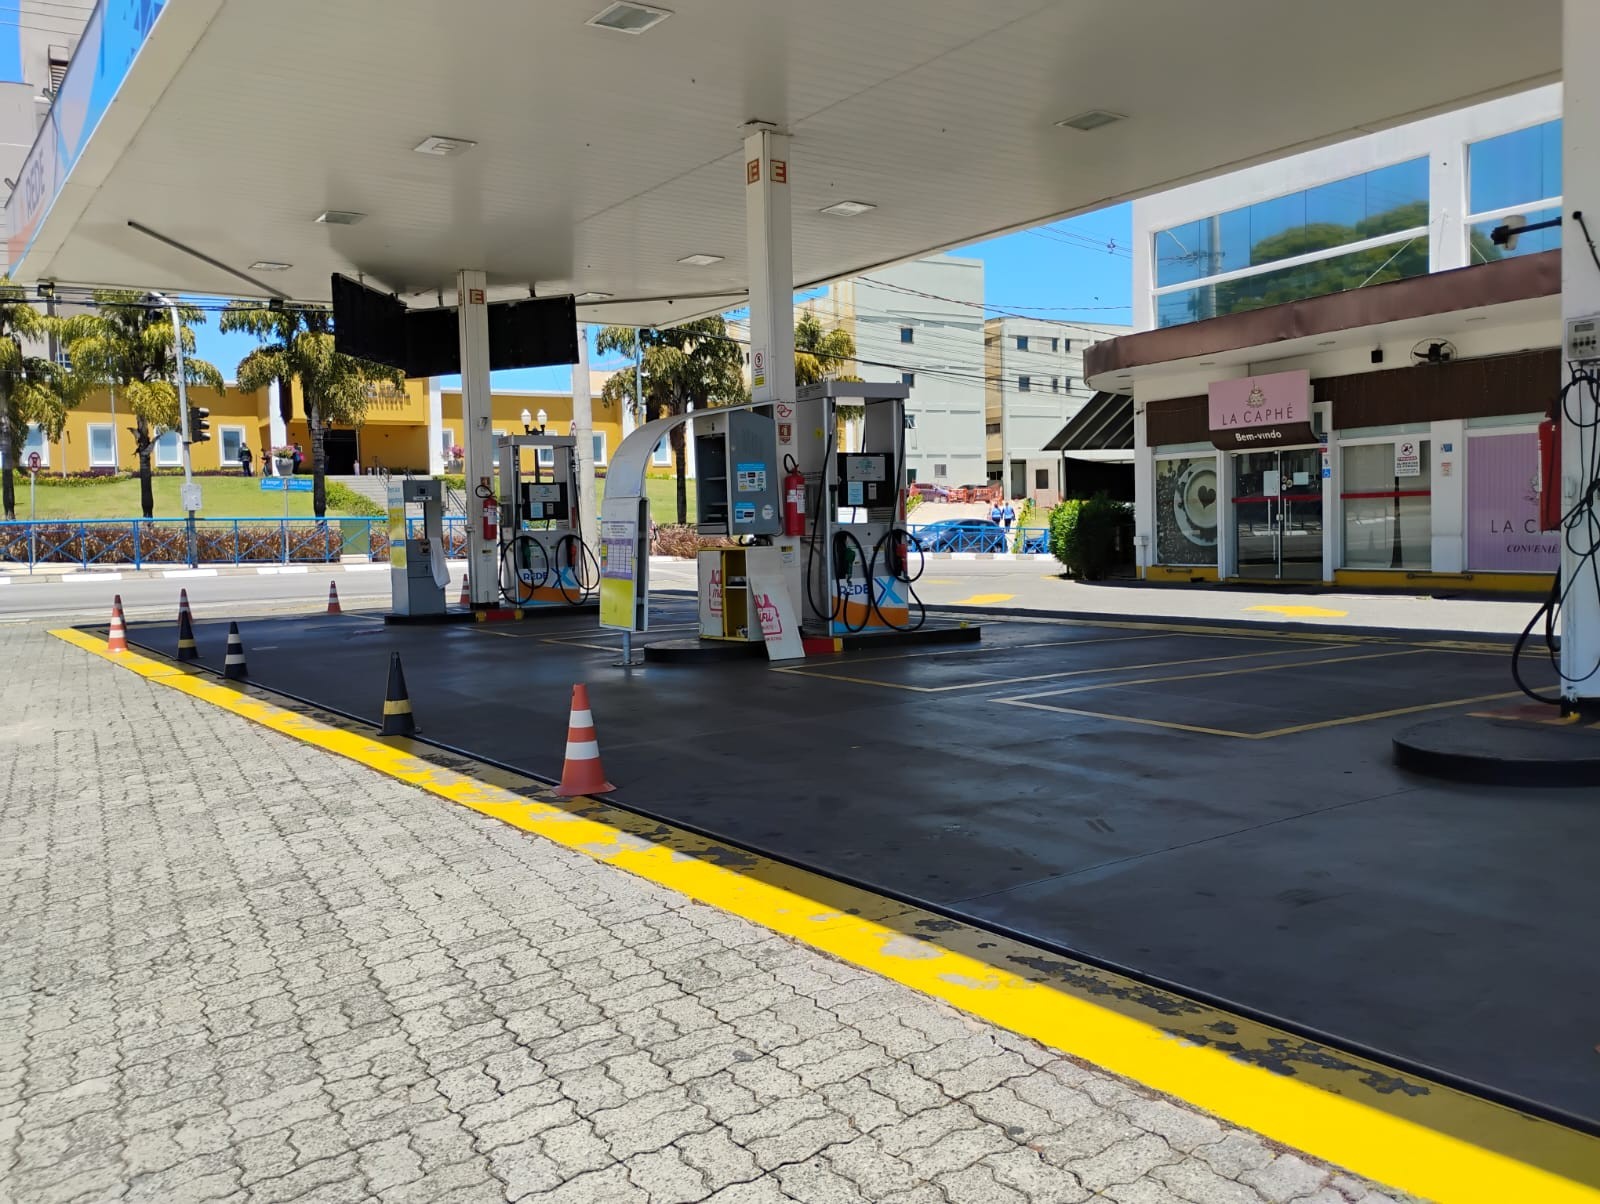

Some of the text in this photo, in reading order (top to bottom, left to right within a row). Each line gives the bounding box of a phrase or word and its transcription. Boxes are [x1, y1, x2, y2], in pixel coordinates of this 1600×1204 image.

[25, 148, 45, 219] REDE
[1222, 402, 1294, 426] LA CAPHÉ
[1235, 429, 1282, 442] Bem-vindo
[1491, 519, 1514, 533] LA
